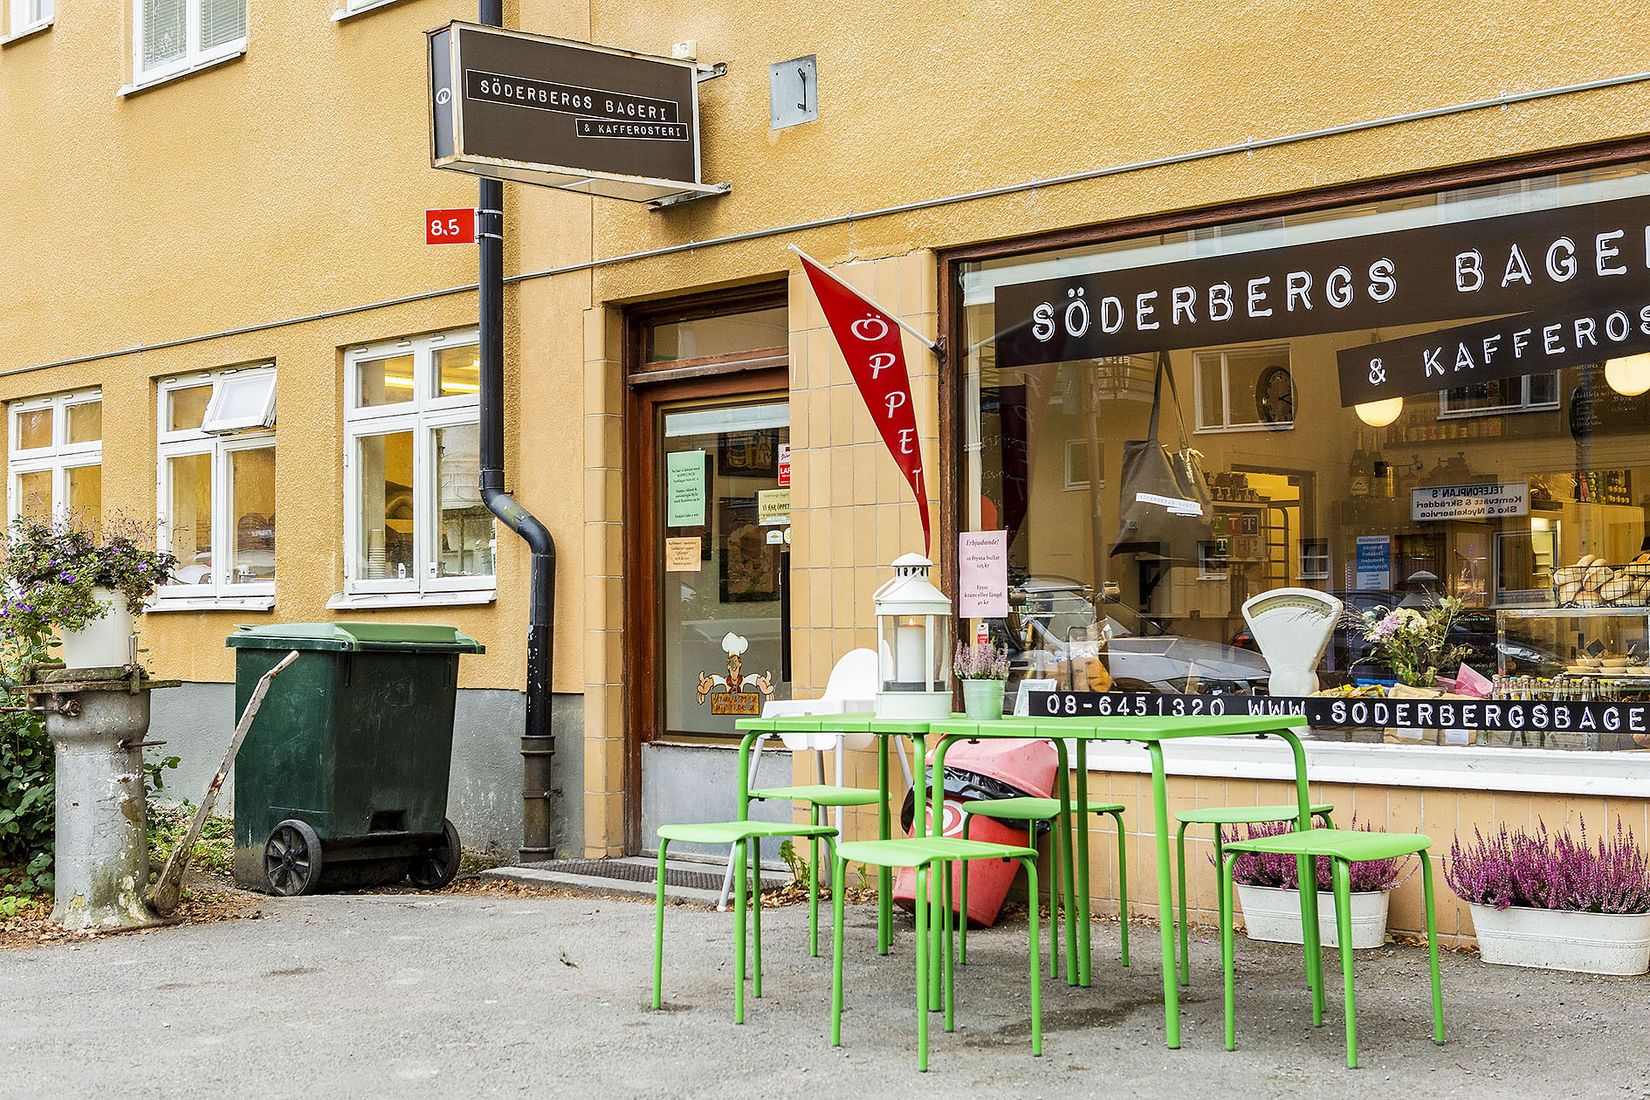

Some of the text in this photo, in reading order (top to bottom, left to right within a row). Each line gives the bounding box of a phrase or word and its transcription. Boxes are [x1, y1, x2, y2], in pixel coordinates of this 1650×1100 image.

[480, 78, 666, 121] SÖDERBERGS BAGERI
[584, 123, 682, 138] & KAFFEROSTERI
[1031, 226, 1650, 343] SÖDERBERGS BAGE
[1368, 357, 1388, 387] &
[851, 313, 922, 494] ÖPPET
[1047, 693, 1226, 716] 08-6451320
